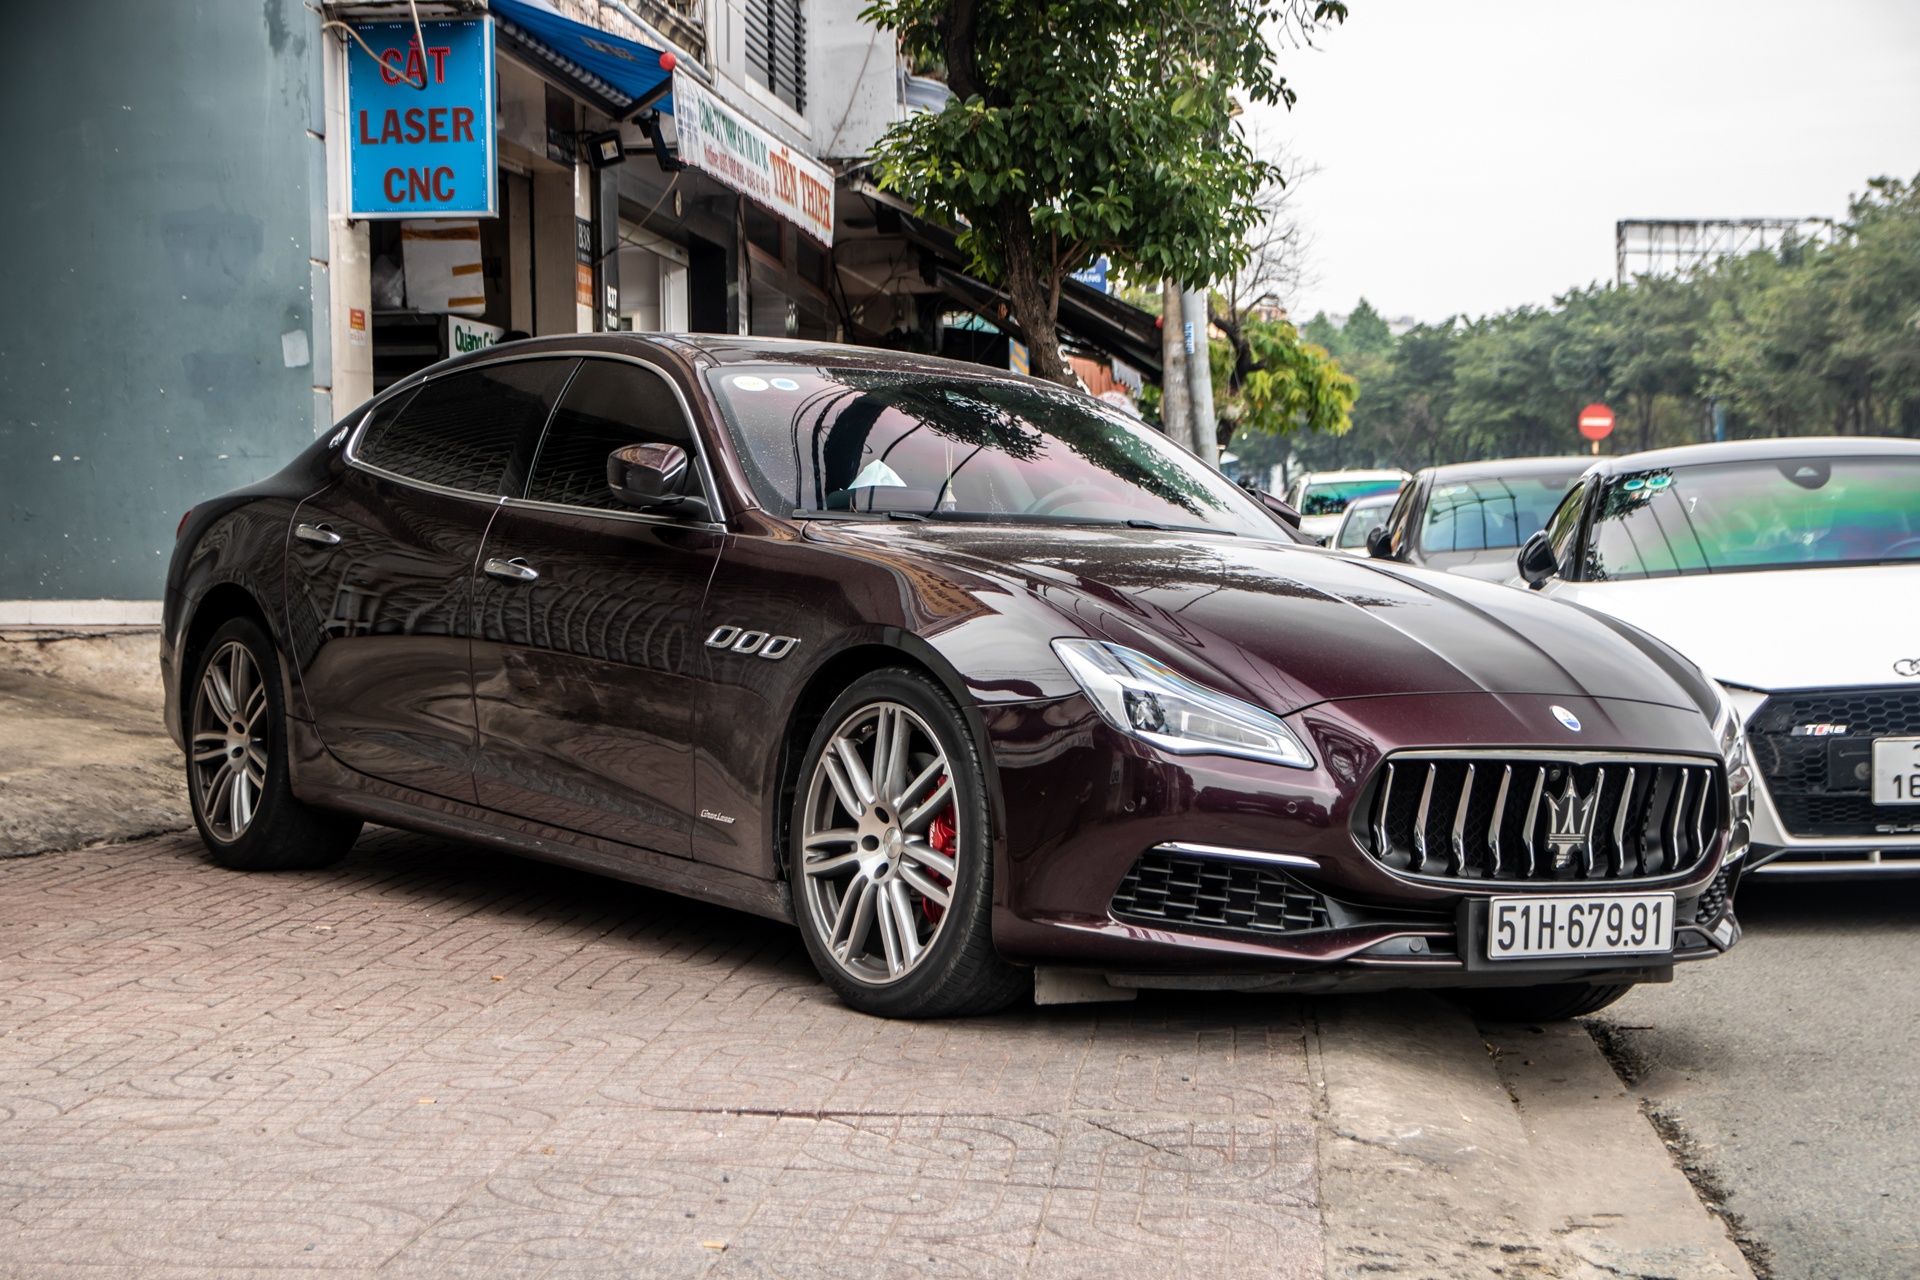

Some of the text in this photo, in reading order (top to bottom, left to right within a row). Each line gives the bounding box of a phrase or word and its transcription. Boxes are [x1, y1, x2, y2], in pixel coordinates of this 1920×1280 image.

[359, 107, 475, 145] LASER
[384, 166, 455, 203] CNC
[578, 223, 591, 252] B38
[607, 284, 618, 310] B37
[1498, 902, 1662, 951] 51H-679.91
